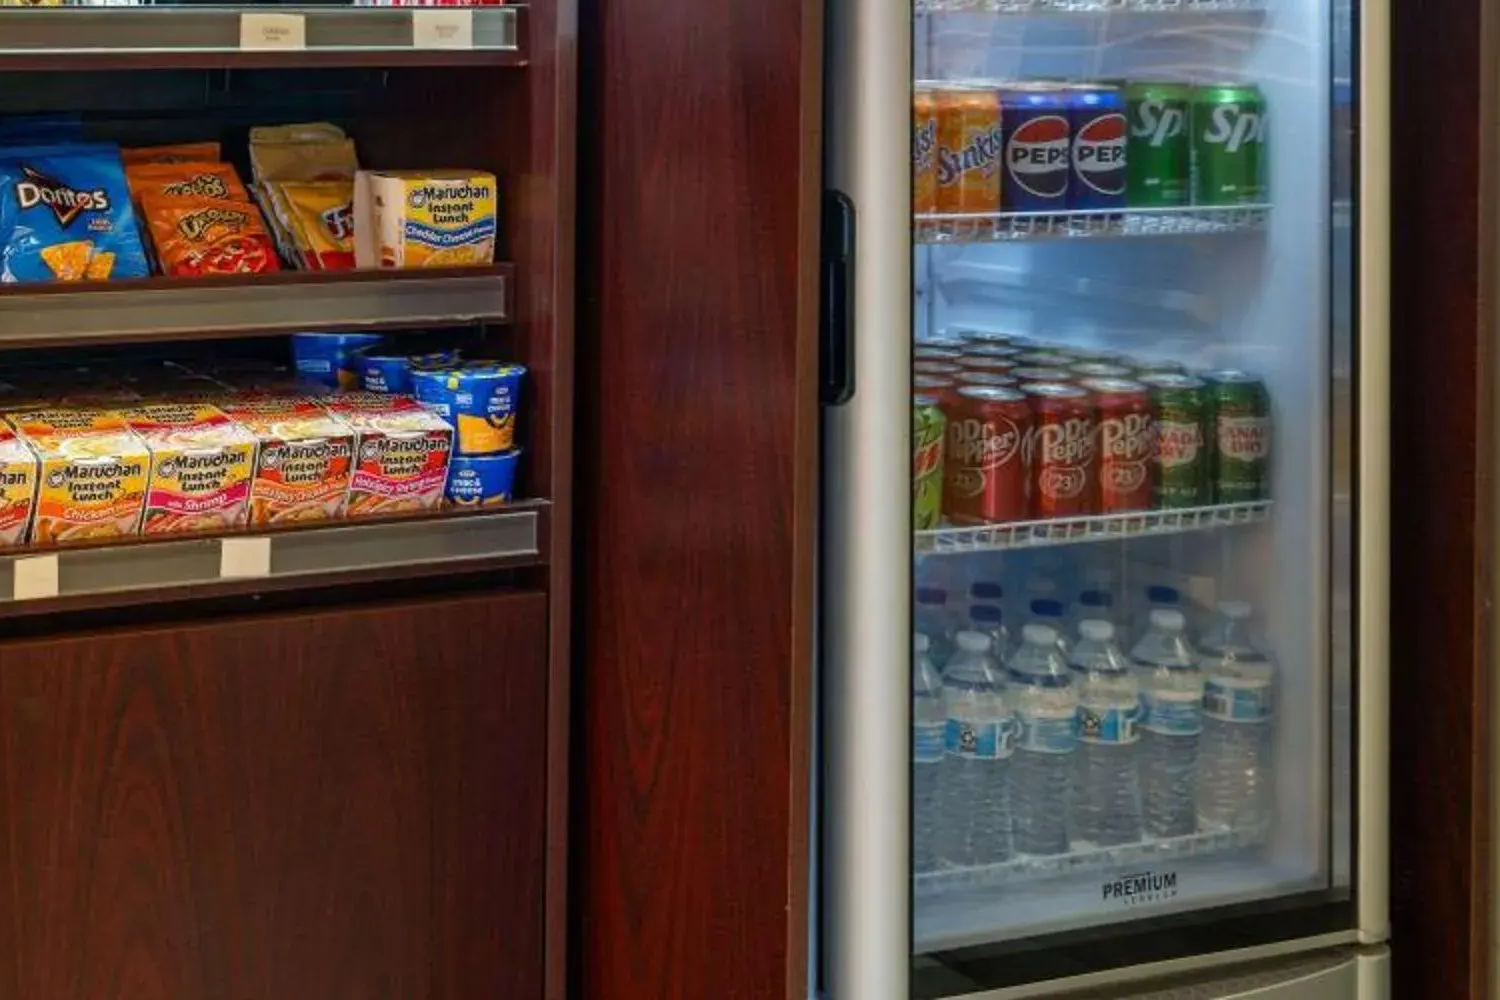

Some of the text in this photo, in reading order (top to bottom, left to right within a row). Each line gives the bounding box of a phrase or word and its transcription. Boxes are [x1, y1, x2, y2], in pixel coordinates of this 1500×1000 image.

[17, 181, 109, 210] Doritos
[423, 186, 489, 201] Maruchan
[428, 201, 474, 213] Instant
[433, 212, 469, 224] Lunch
[377, 437, 448, 452] Maruchan
[277, 443, 348, 460] Maruchan
[174, 450, 246, 469] Maruchan
[380, 453, 428, 465] Instant
[65, 463, 141, 480] Maruchan
[280, 460, 329, 473] Instant
[384, 464, 422, 476] Lunch
[177, 467, 227, 482] Instant
[285, 471, 322, 483] Lunch
[68, 479, 121, 493] Instant
[182, 480, 221, 492] Lunch
[72, 491, 114, 502] Lunch
